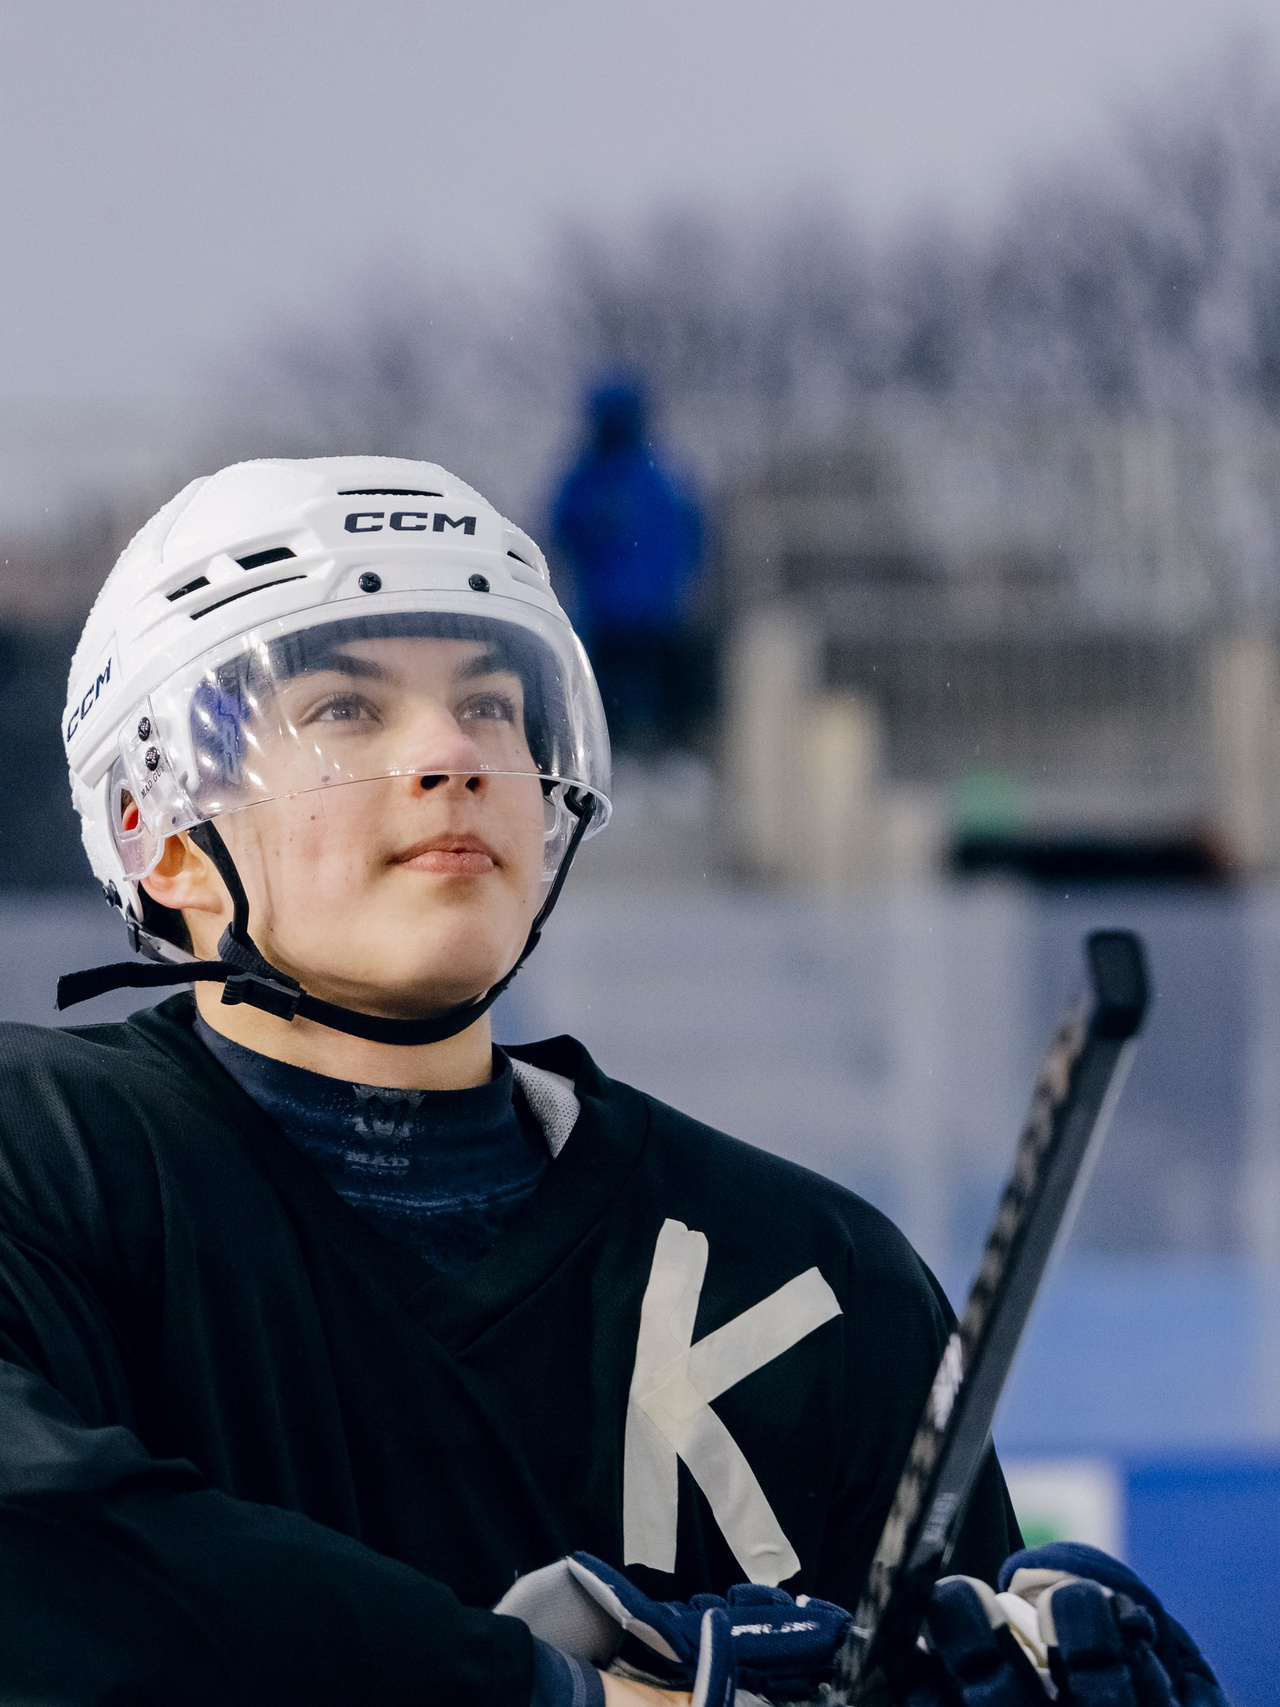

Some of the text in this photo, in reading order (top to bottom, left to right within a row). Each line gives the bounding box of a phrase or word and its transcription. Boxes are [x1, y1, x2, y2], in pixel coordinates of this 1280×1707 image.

[344, 511, 477, 536] CCM
[66, 656, 112, 743] CCM
[140, 779, 153, 800] MAD
[623, 1217, 844, 1588] K
